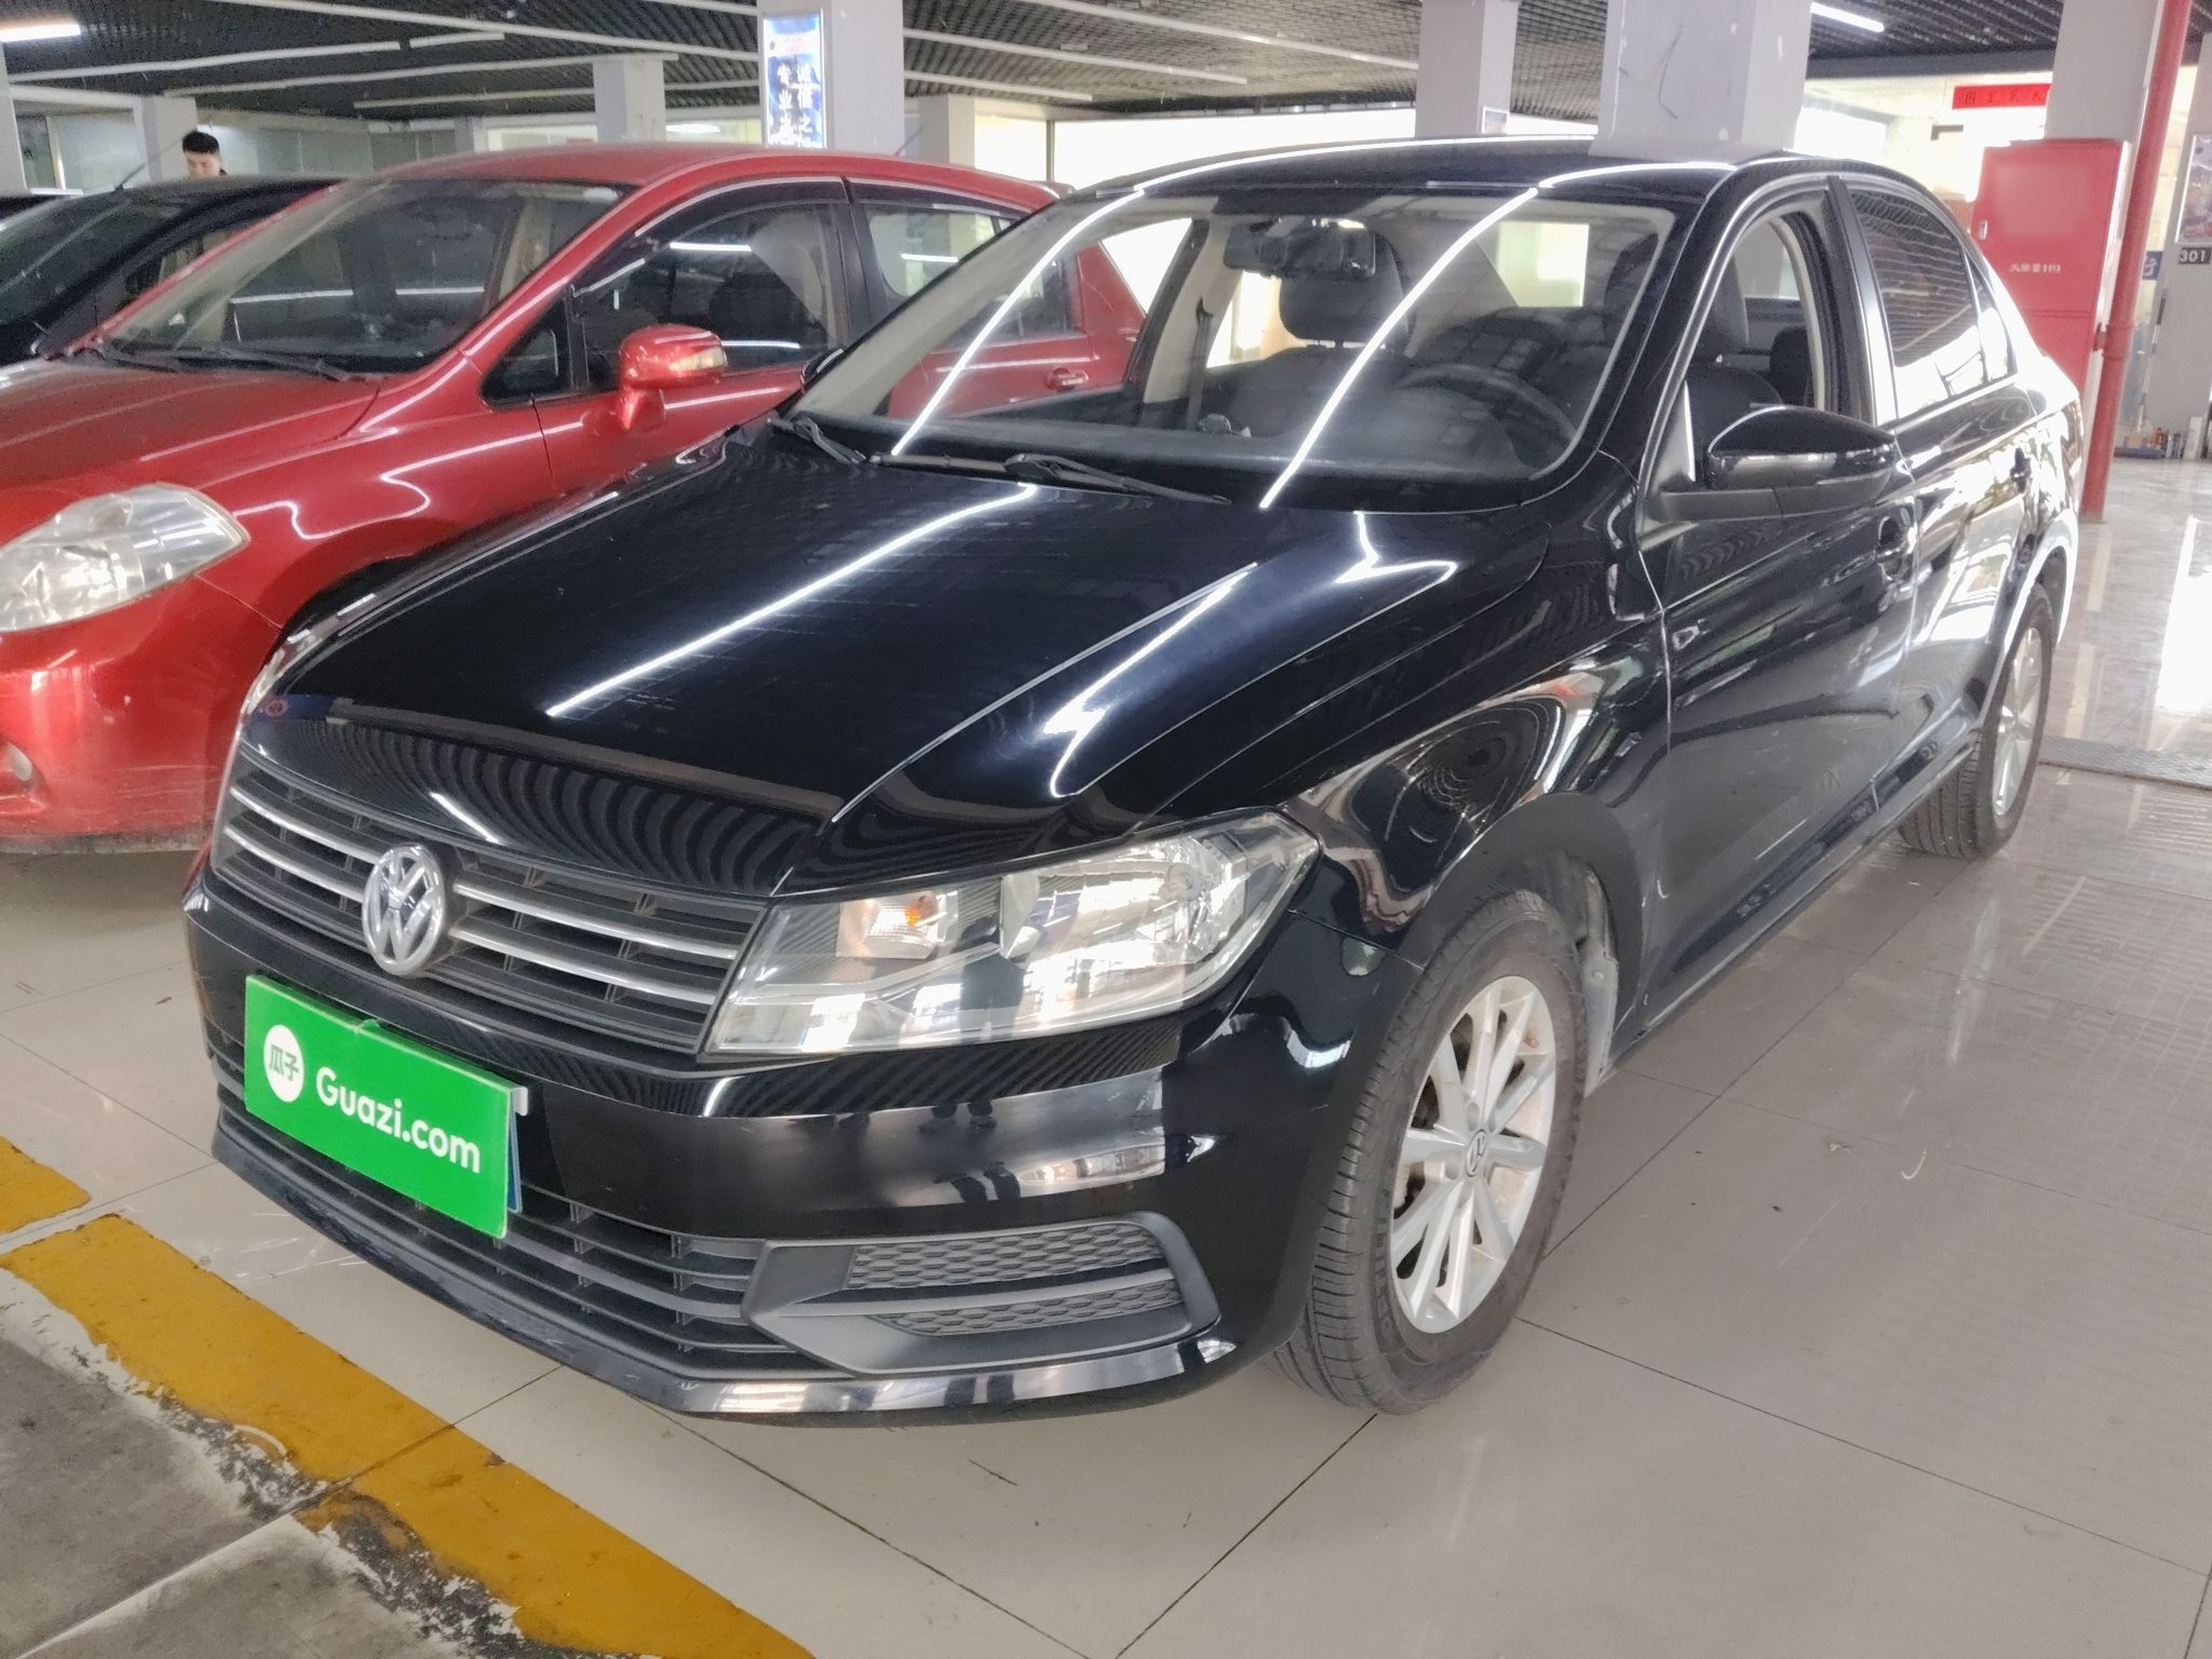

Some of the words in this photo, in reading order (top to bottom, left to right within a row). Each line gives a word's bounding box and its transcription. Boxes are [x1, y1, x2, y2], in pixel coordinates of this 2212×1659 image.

[2179, 249, 2206, 263] 301
[269, 1043, 300, 1081] 瓜子
[316, 1066, 481, 1174] Guazi.com
